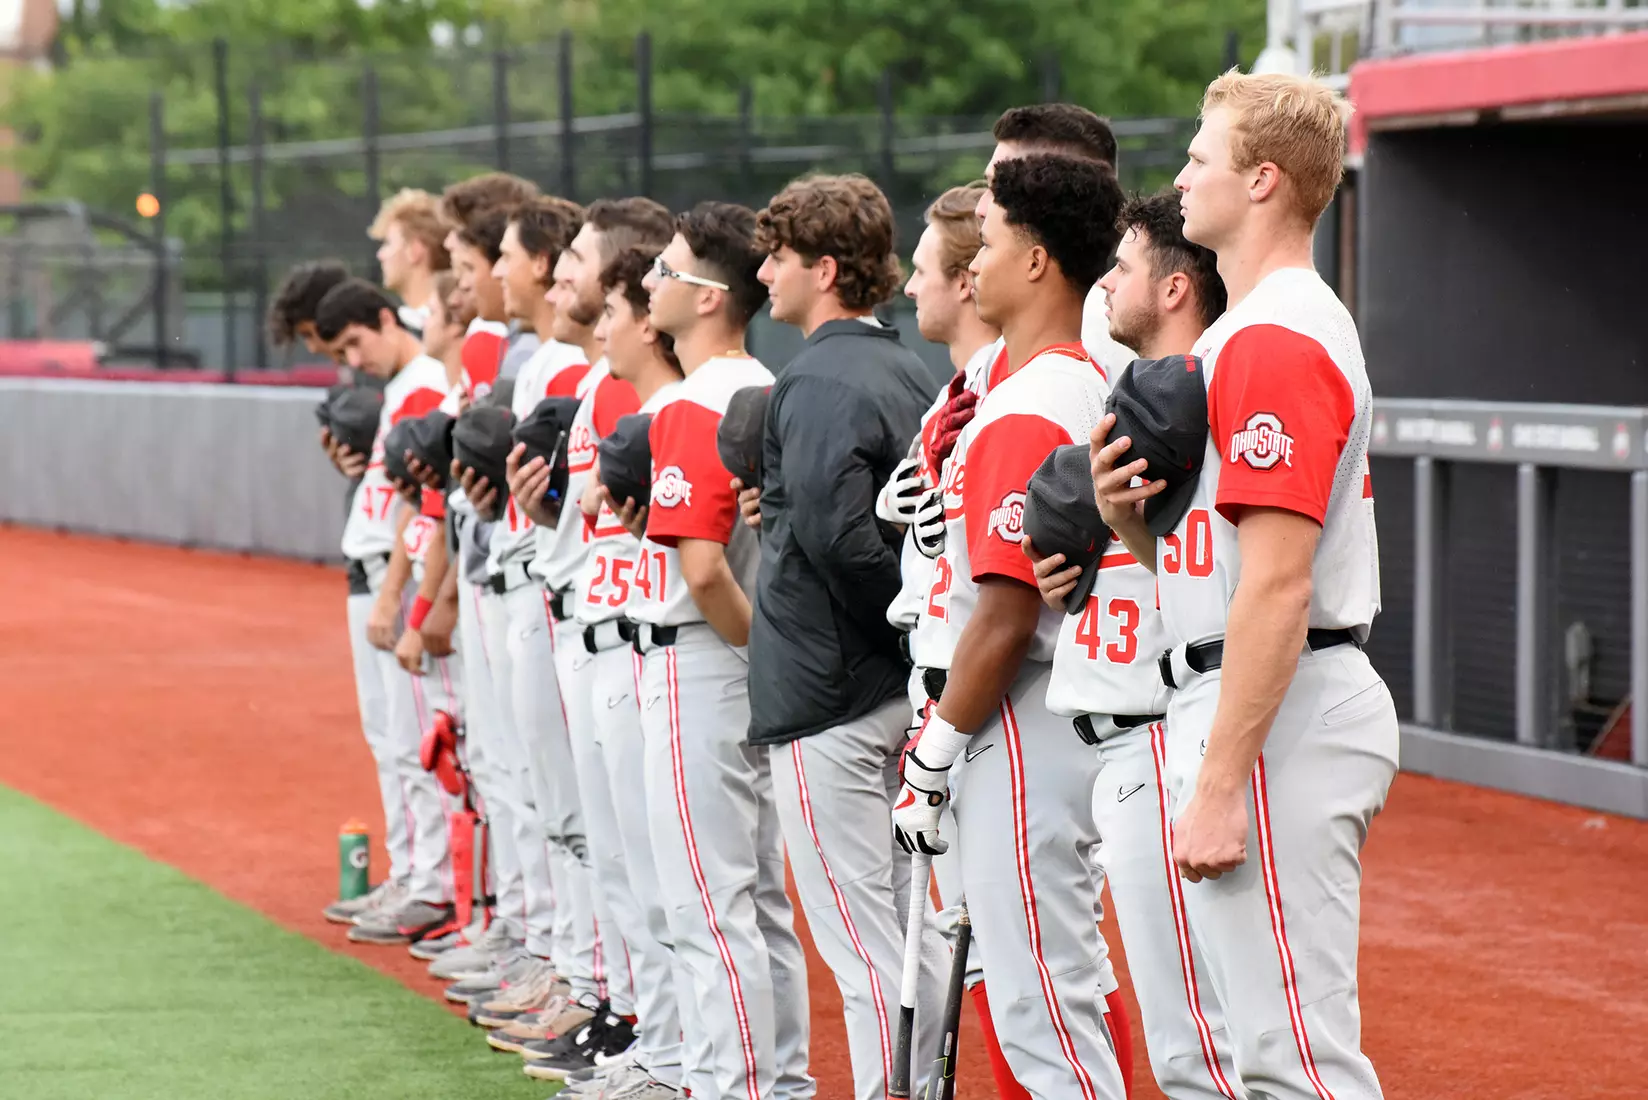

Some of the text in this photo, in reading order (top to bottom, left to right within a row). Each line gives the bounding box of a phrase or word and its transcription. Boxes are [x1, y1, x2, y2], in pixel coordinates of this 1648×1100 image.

[1163, 508, 1215, 578] 50
[587, 555, 634, 608] 25
[635, 547, 667, 603] 41
[1074, 595, 1140, 664] 43
